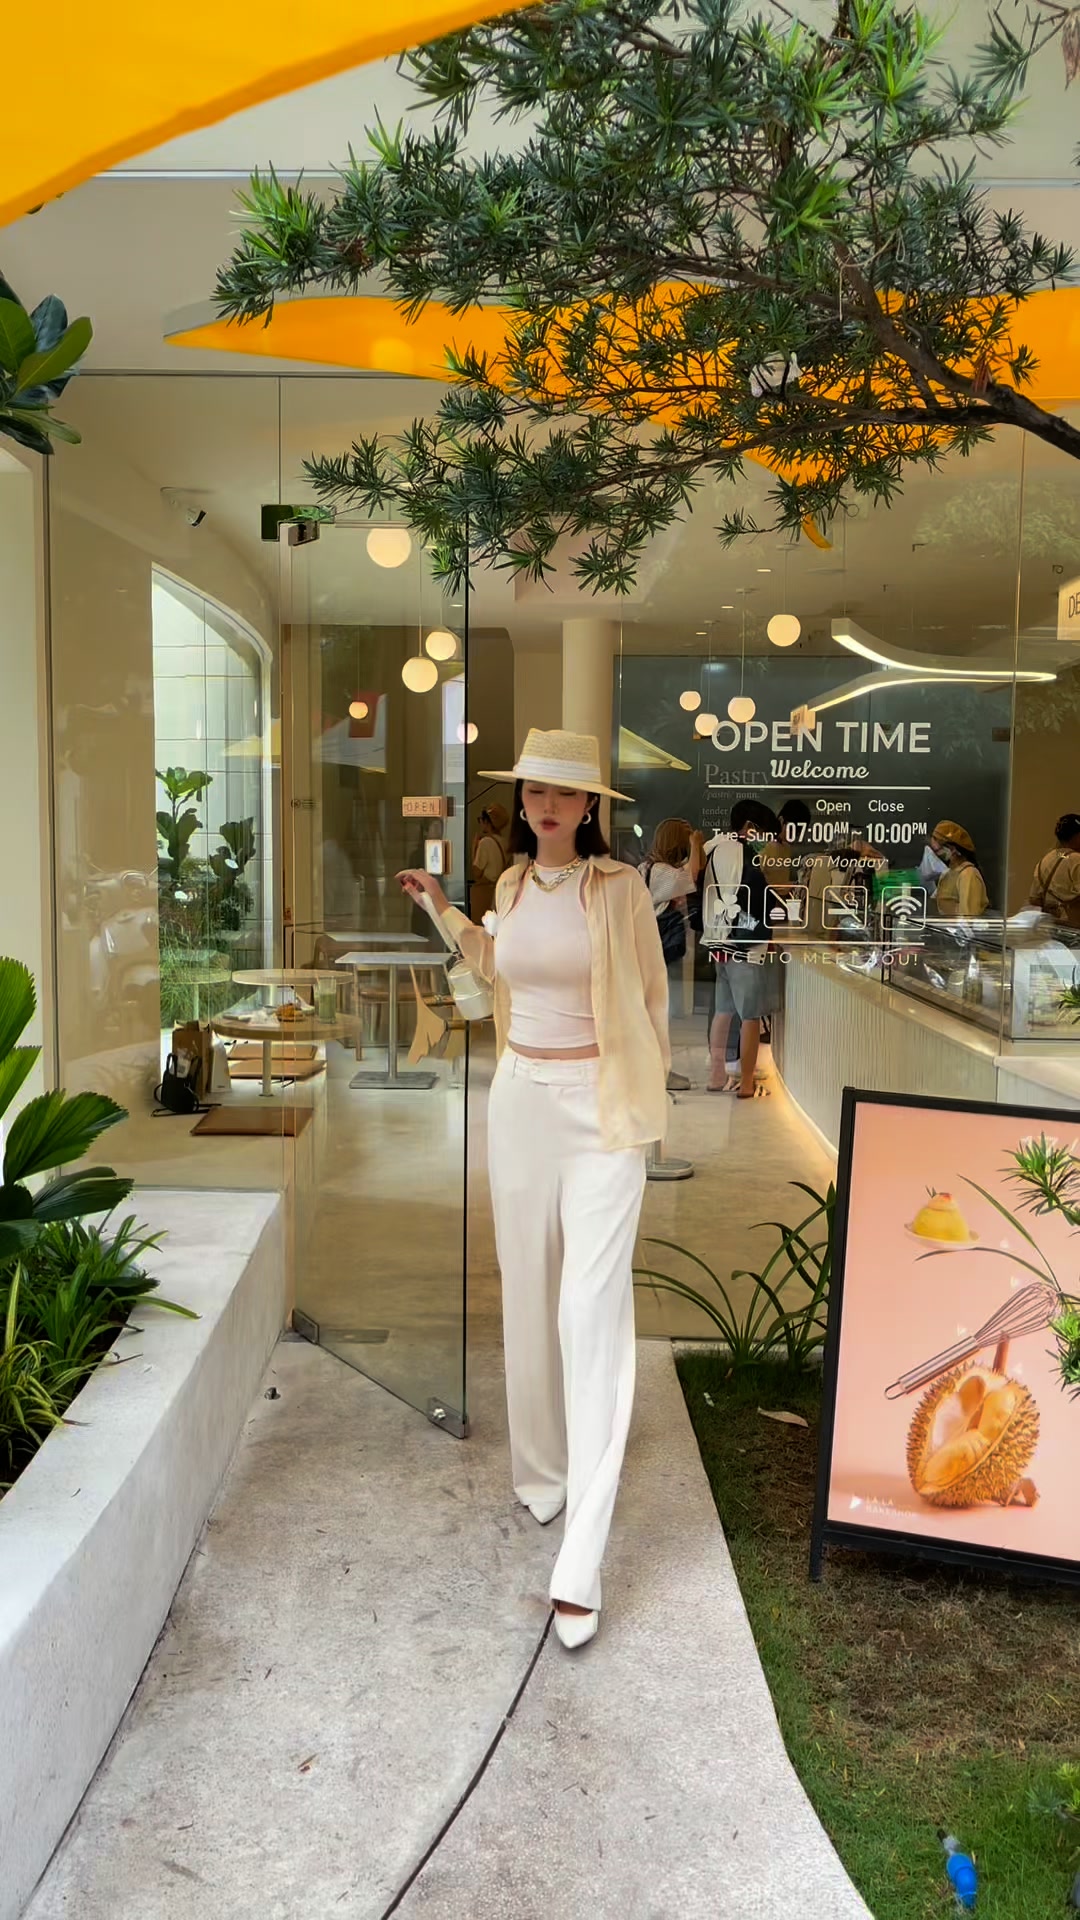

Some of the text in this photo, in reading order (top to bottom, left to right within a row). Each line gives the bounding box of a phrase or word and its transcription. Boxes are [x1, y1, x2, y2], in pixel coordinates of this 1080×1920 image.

[711, 720, 931, 753] OPEN TIME
[704, 763, 769, 791] Pastry
[770, 758, 869, 779] Welcome
[406, 801, 435, 812] OPEN
[816, 799, 851, 815] Open
[868, 799, 905, 812] Close
[751, 854, 885, 871] Closed on Monday
[767, 951, 792, 964] TO
[866, 952, 918, 966] OU!
